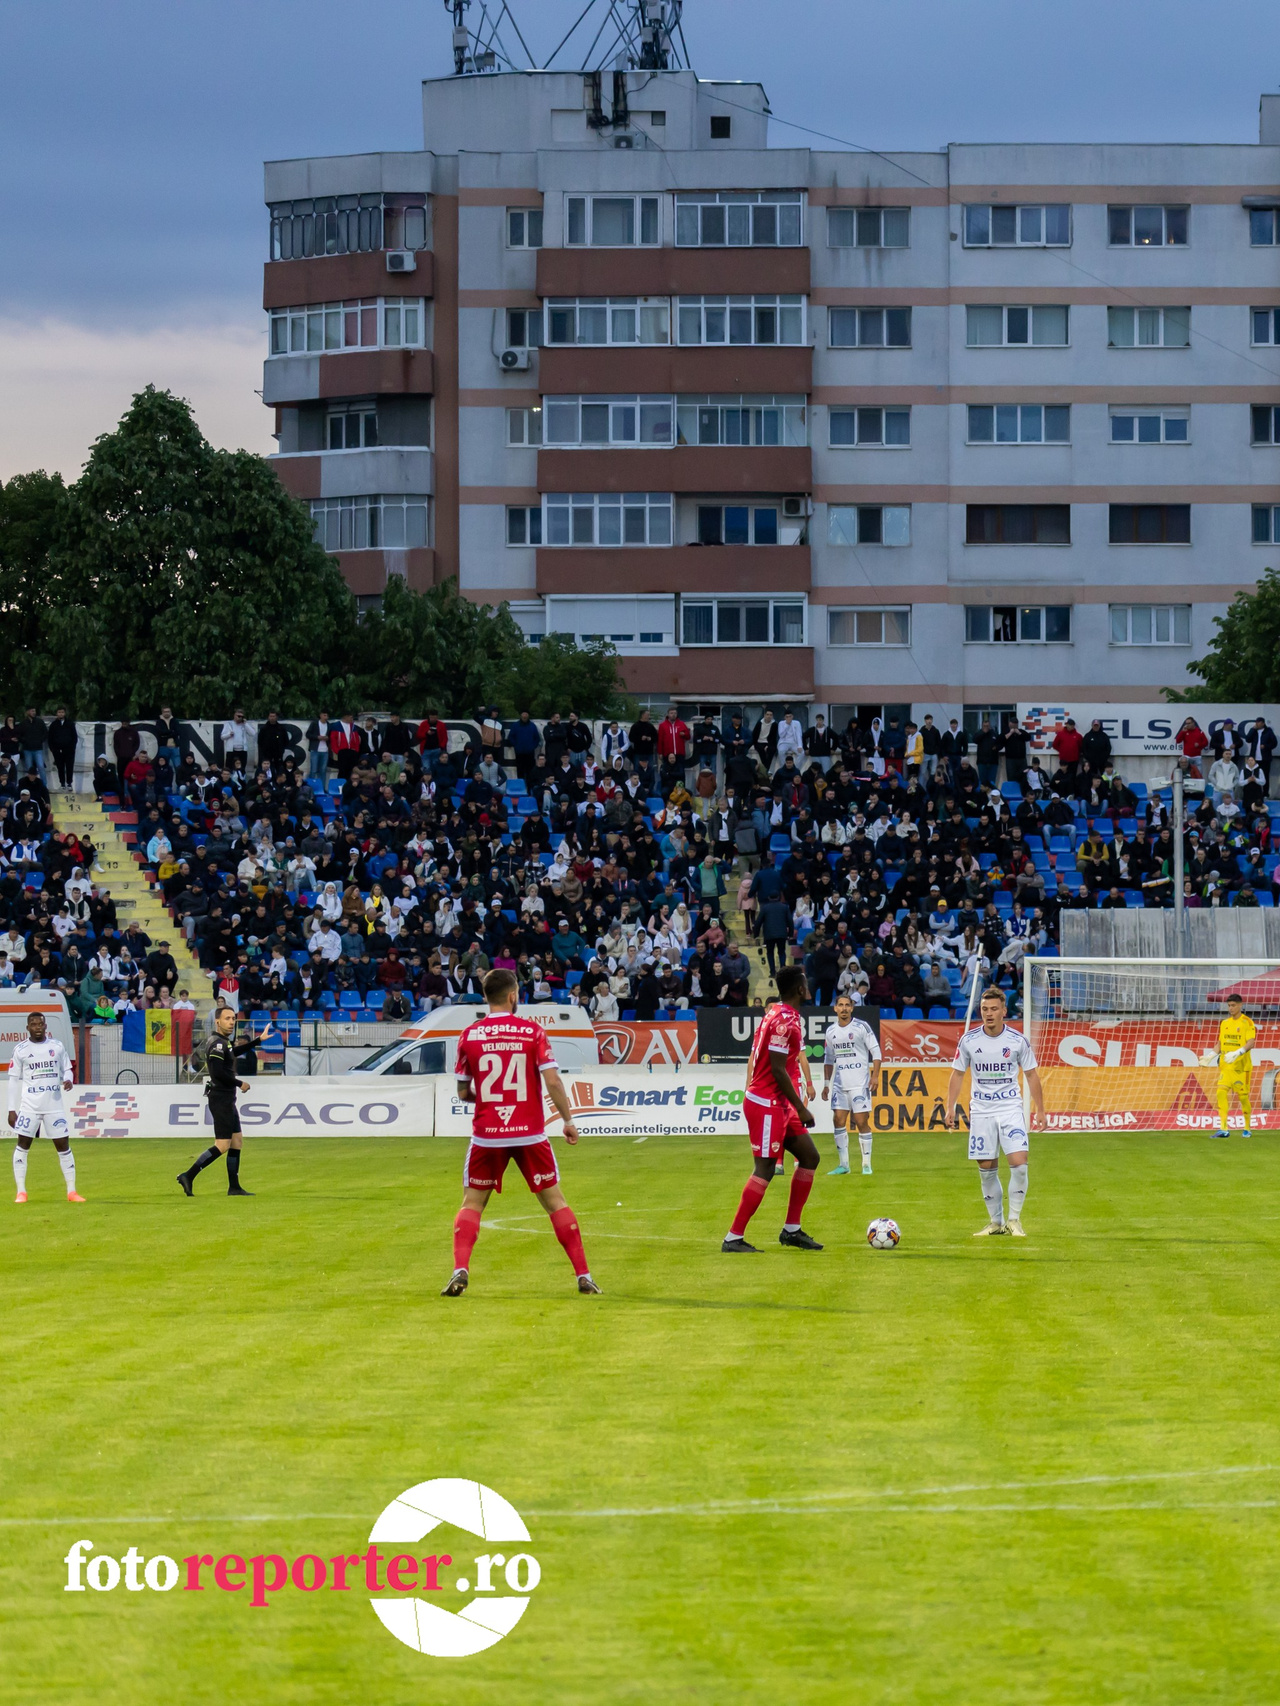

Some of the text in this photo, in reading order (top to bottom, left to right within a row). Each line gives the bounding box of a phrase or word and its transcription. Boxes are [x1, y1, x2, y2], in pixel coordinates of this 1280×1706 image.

[477, 1023, 534, 1036] Regata.ro
[482, 1043, 523, 1052] VELKOVSKI
[29, 1060, 58, 1071] UNIBET
[975, 1062, 1013, 1073] UNIBET
[478, 1053, 527, 1103] 24
[598, 1085, 746, 1107] Smart Eco
[697, 1106, 742, 1122] Plus
[17, 1115, 31, 1129] 83
[500, 1125, 529, 1133] GAMING
[970, 1135, 985, 1152] 33
